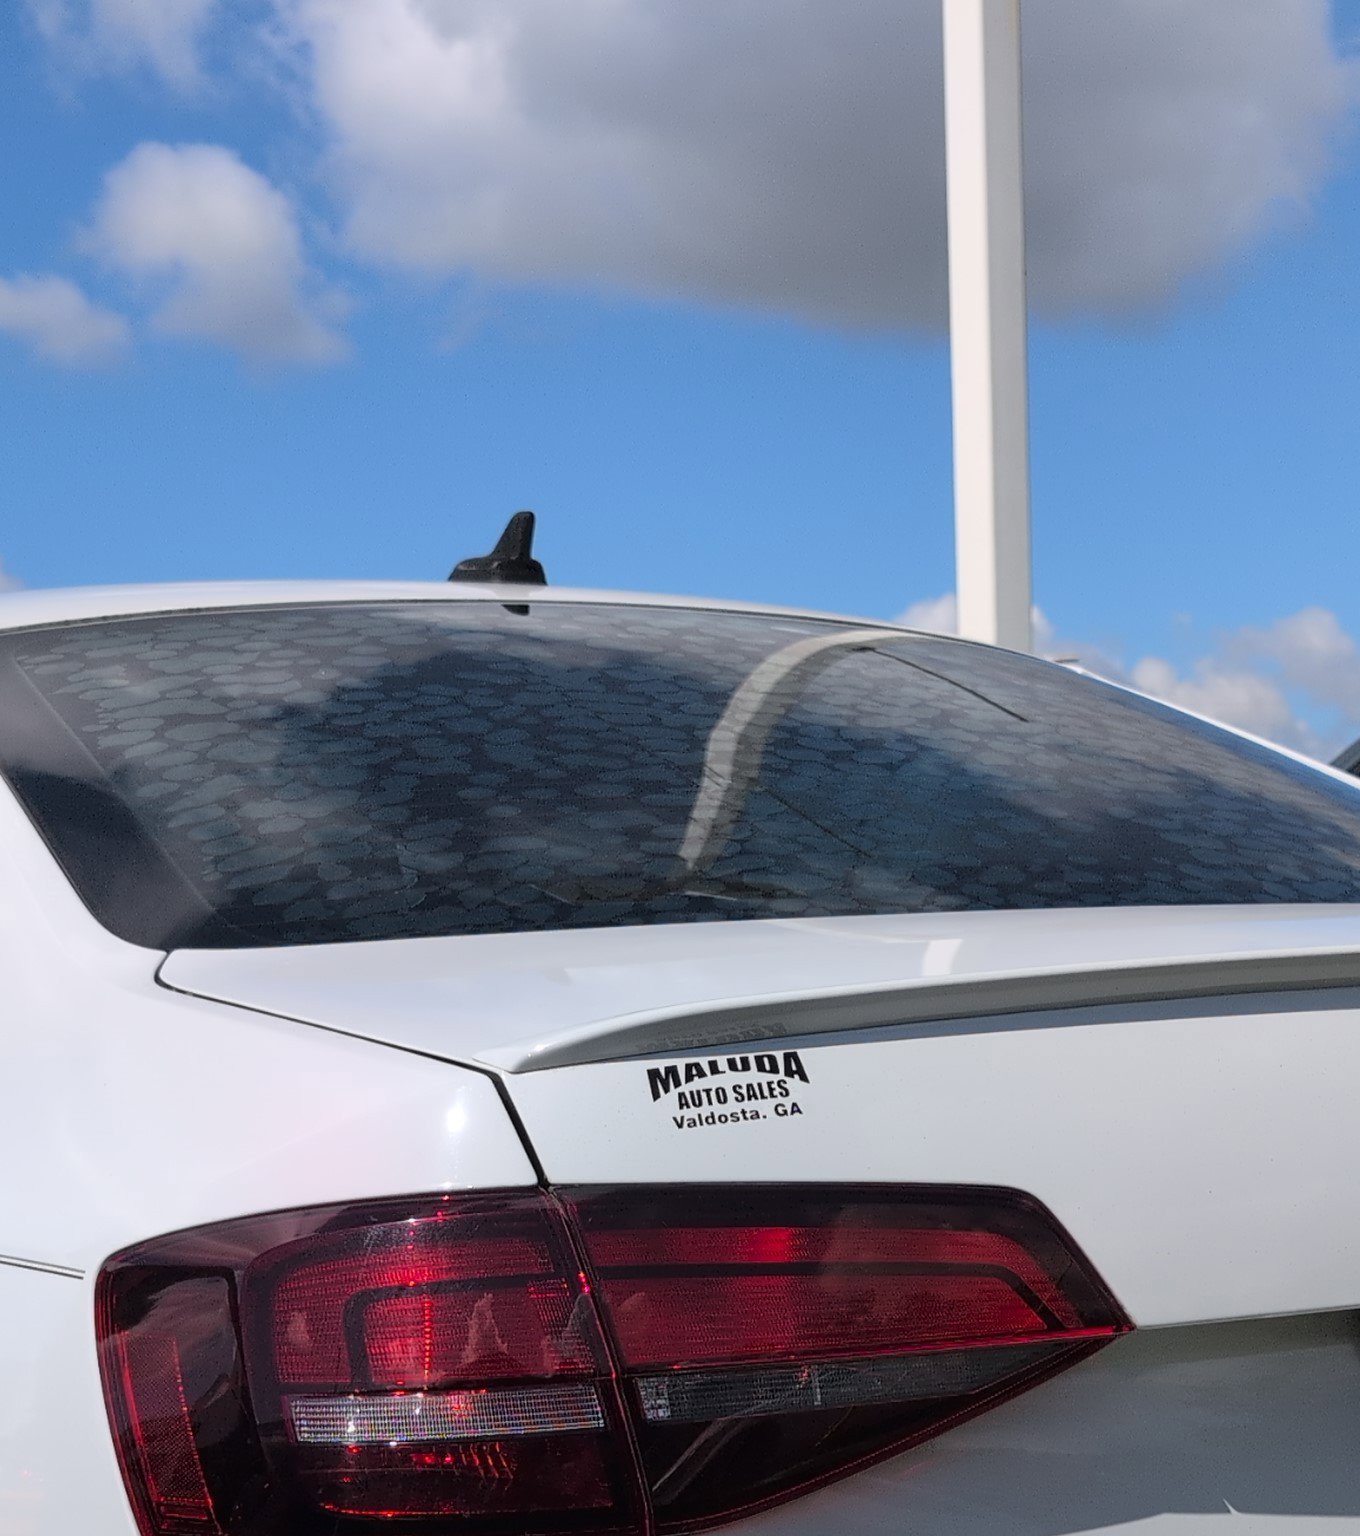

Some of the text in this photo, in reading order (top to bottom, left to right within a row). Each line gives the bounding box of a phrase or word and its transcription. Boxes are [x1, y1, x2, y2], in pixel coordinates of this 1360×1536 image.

[647, 1051, 810, 1102] MALUDA
[678, 1079, 790, 1110] AUTO SALES
[774, 1102, 803, 1117] GA
